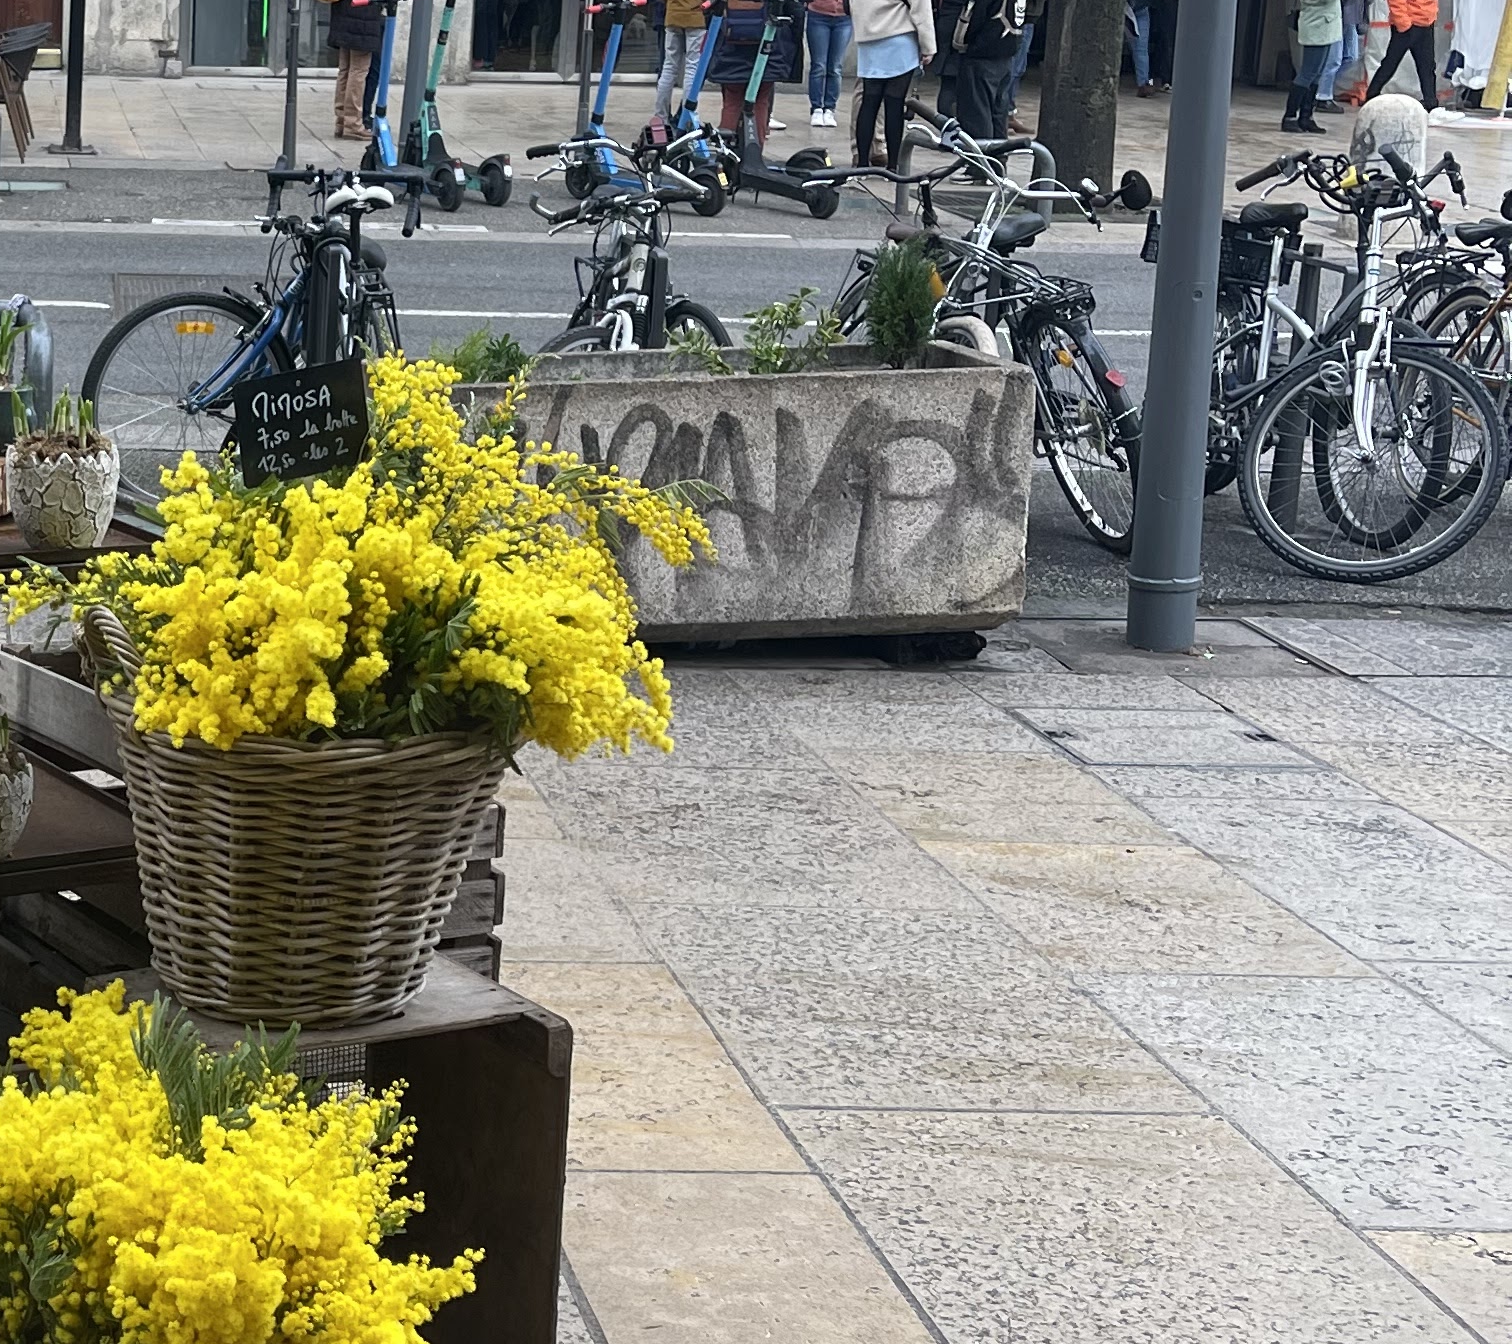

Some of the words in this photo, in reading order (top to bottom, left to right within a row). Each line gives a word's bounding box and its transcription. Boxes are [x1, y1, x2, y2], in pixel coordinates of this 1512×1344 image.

[257, 427, 291, 450] 7,50
[299, 418, 320, 439] la
[323, 409, 359, 432] botte
[257, 453, 296, 475] 12,50
[335, 436, 349, 455] 2
